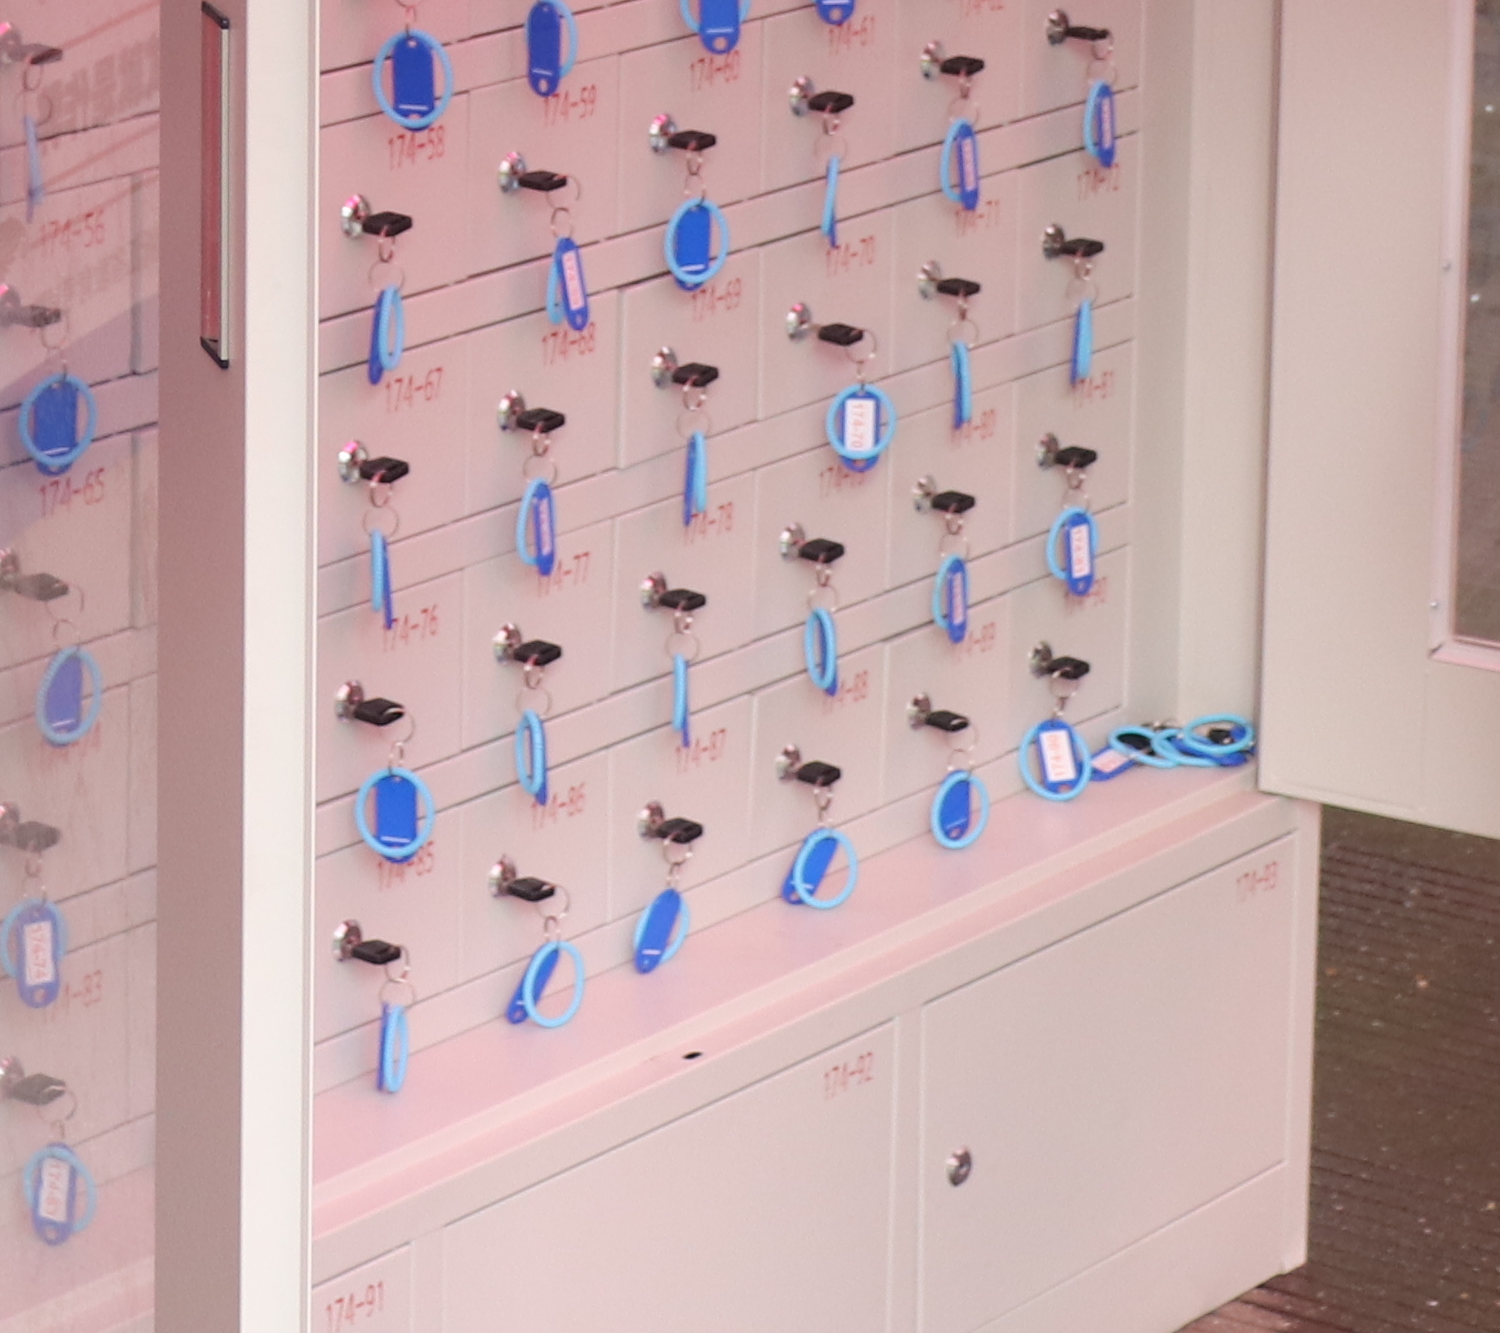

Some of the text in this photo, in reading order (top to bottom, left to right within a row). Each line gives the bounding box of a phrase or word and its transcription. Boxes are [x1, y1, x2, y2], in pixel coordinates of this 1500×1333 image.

[543, 85, 597, 127] 174-59
[388, 125, 445, 171] 174-58
[386, 367, 443, 411] 174-67
